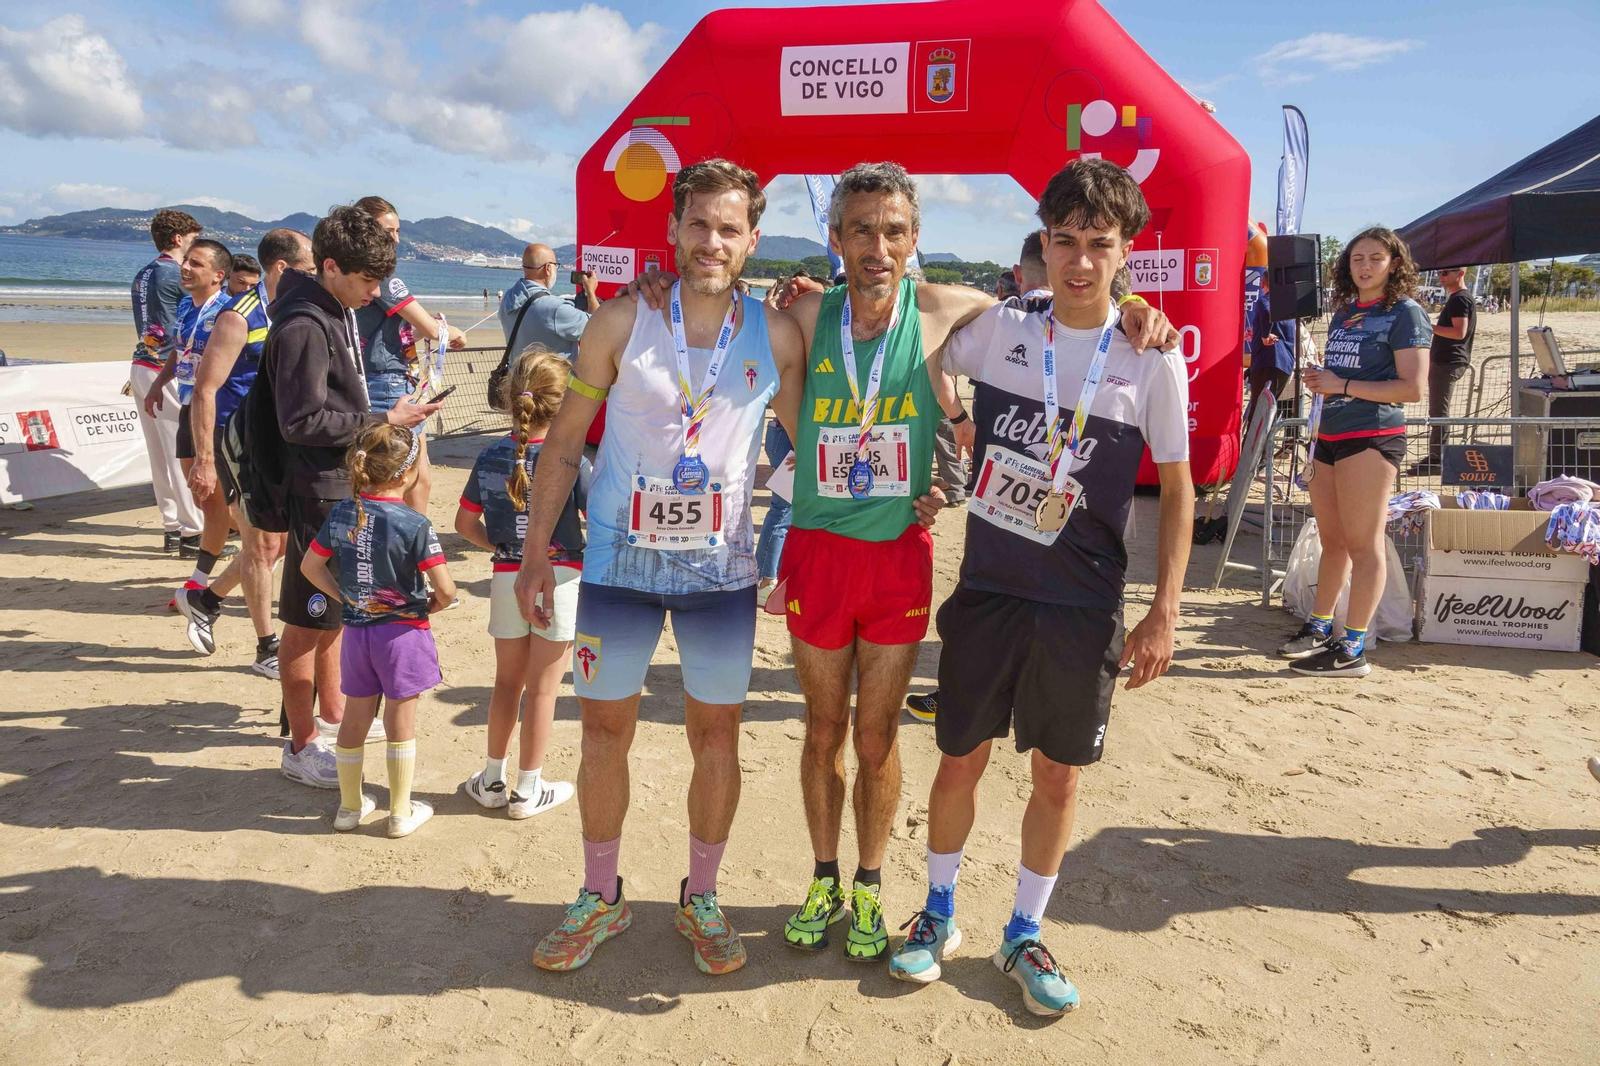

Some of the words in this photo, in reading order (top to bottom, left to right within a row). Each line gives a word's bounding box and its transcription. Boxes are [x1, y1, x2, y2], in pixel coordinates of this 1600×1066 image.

[789, 57, 898, 77] CONCELLO
[802, 82, 828, 99] DE
[835, 80, 884, 99] VIGO
[583, 252, 630, 265] CONCELLO
[1125, 258, 1177, 271] NCELLO
[599, 265, 623, 276] VIGO
[1136, 272, 1169, 283] VIGO
[1324, 340, 1361, 354] CARREIRA
[1333, 354, 1362, 369] SAMIL
[75, 410, 138, 425] CONCELLO
[86, 426, 104, 437] DE
[106, 423, 135, 434] VIGO
[1020, 463, 1046, 477] CARREIRA
[1459, 472, 1497, 482] SOLVE
[996, 473, 1048, 513] 705
[649, 501, 702, 525] 455
[368, 514, 376, 534] SAMIL
[515, 514, 529, 539] 100
[1463, 557, 1552, 570] www.ifeelwood.org
[357, 562, 370, 584] 100
[1453, 618, 1499, 627] ORIGINAL
[1502, 621, 1549, 630] TROPHIES
[1456, 628, 1543, 641] www.ifeelwood.org
[1093, 723, 1107, 747] FILA
